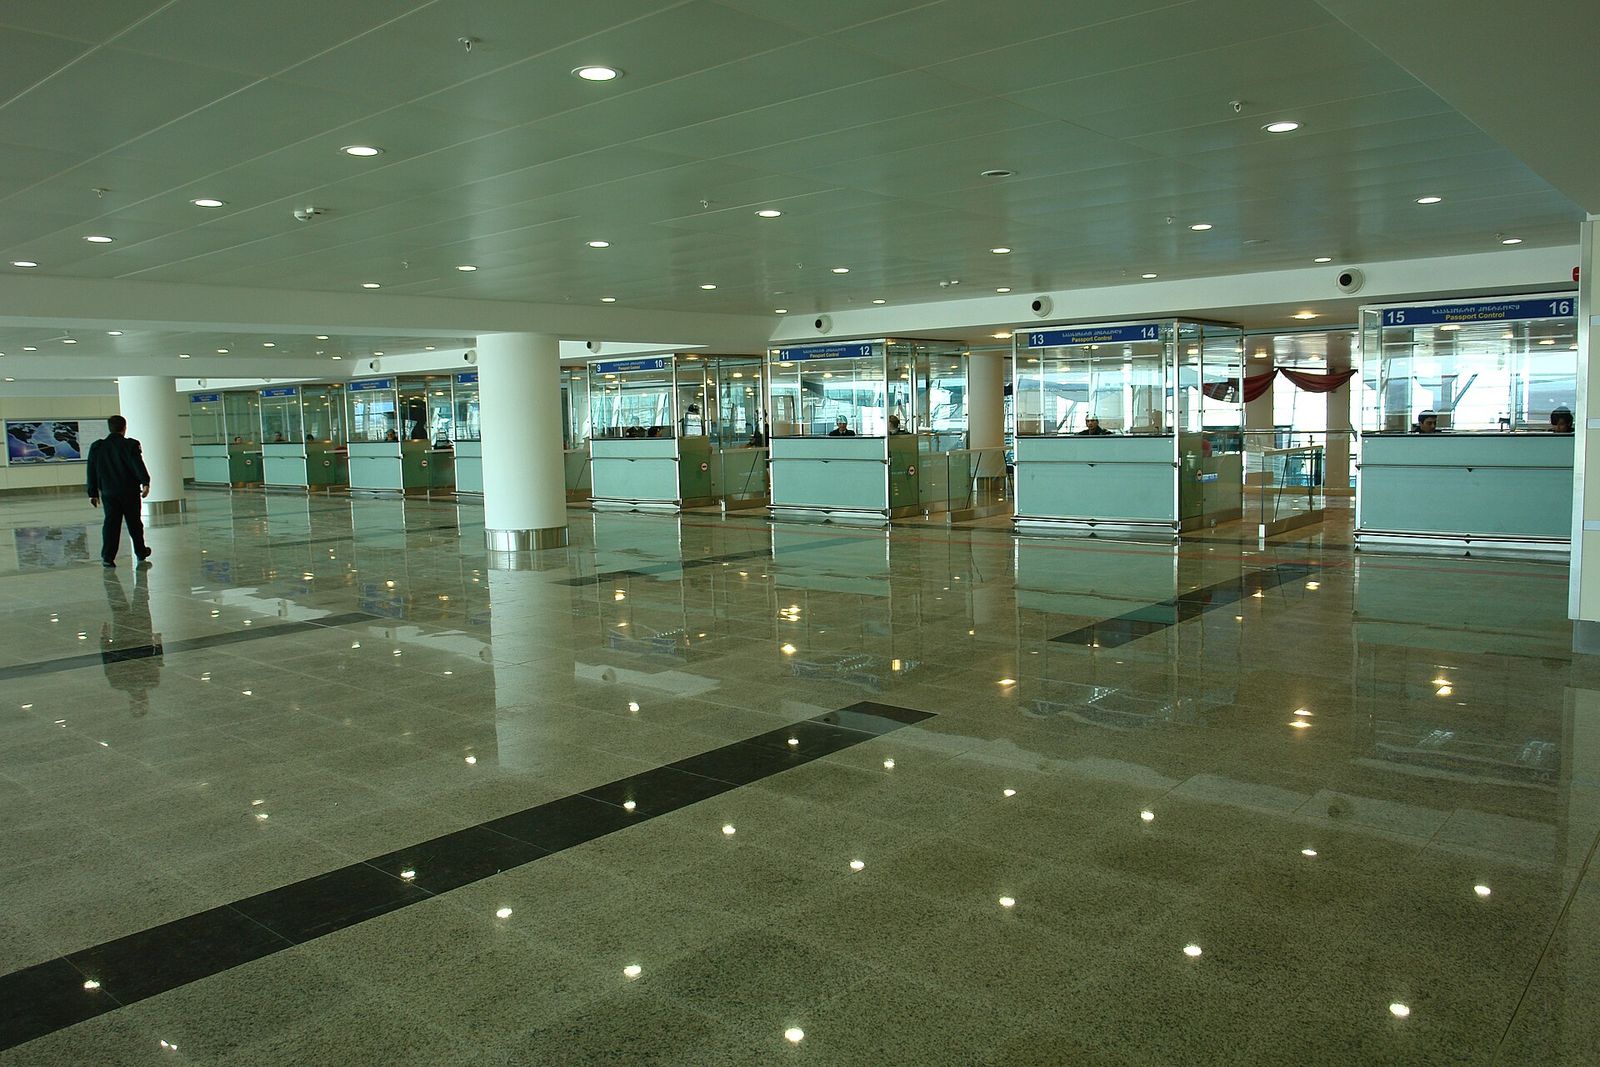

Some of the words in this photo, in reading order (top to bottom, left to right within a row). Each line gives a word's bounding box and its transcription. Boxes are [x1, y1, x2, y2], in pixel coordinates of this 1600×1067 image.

[1549, 301, 1570, 315] 16
[1387, 310, 1405, 324] 15
[1445, 313, 1477, 321] Passport
[1478, 311, 1505, 319] Control
[1141, 327, 1155, 338] 14
[1031, 334, 1044, 345] 13
[781, 351, 789, 360] 11
[859, 346, 870, 355] 12
[596, 364, 602, 372] 9
[654, 360, 663, 368] 10
